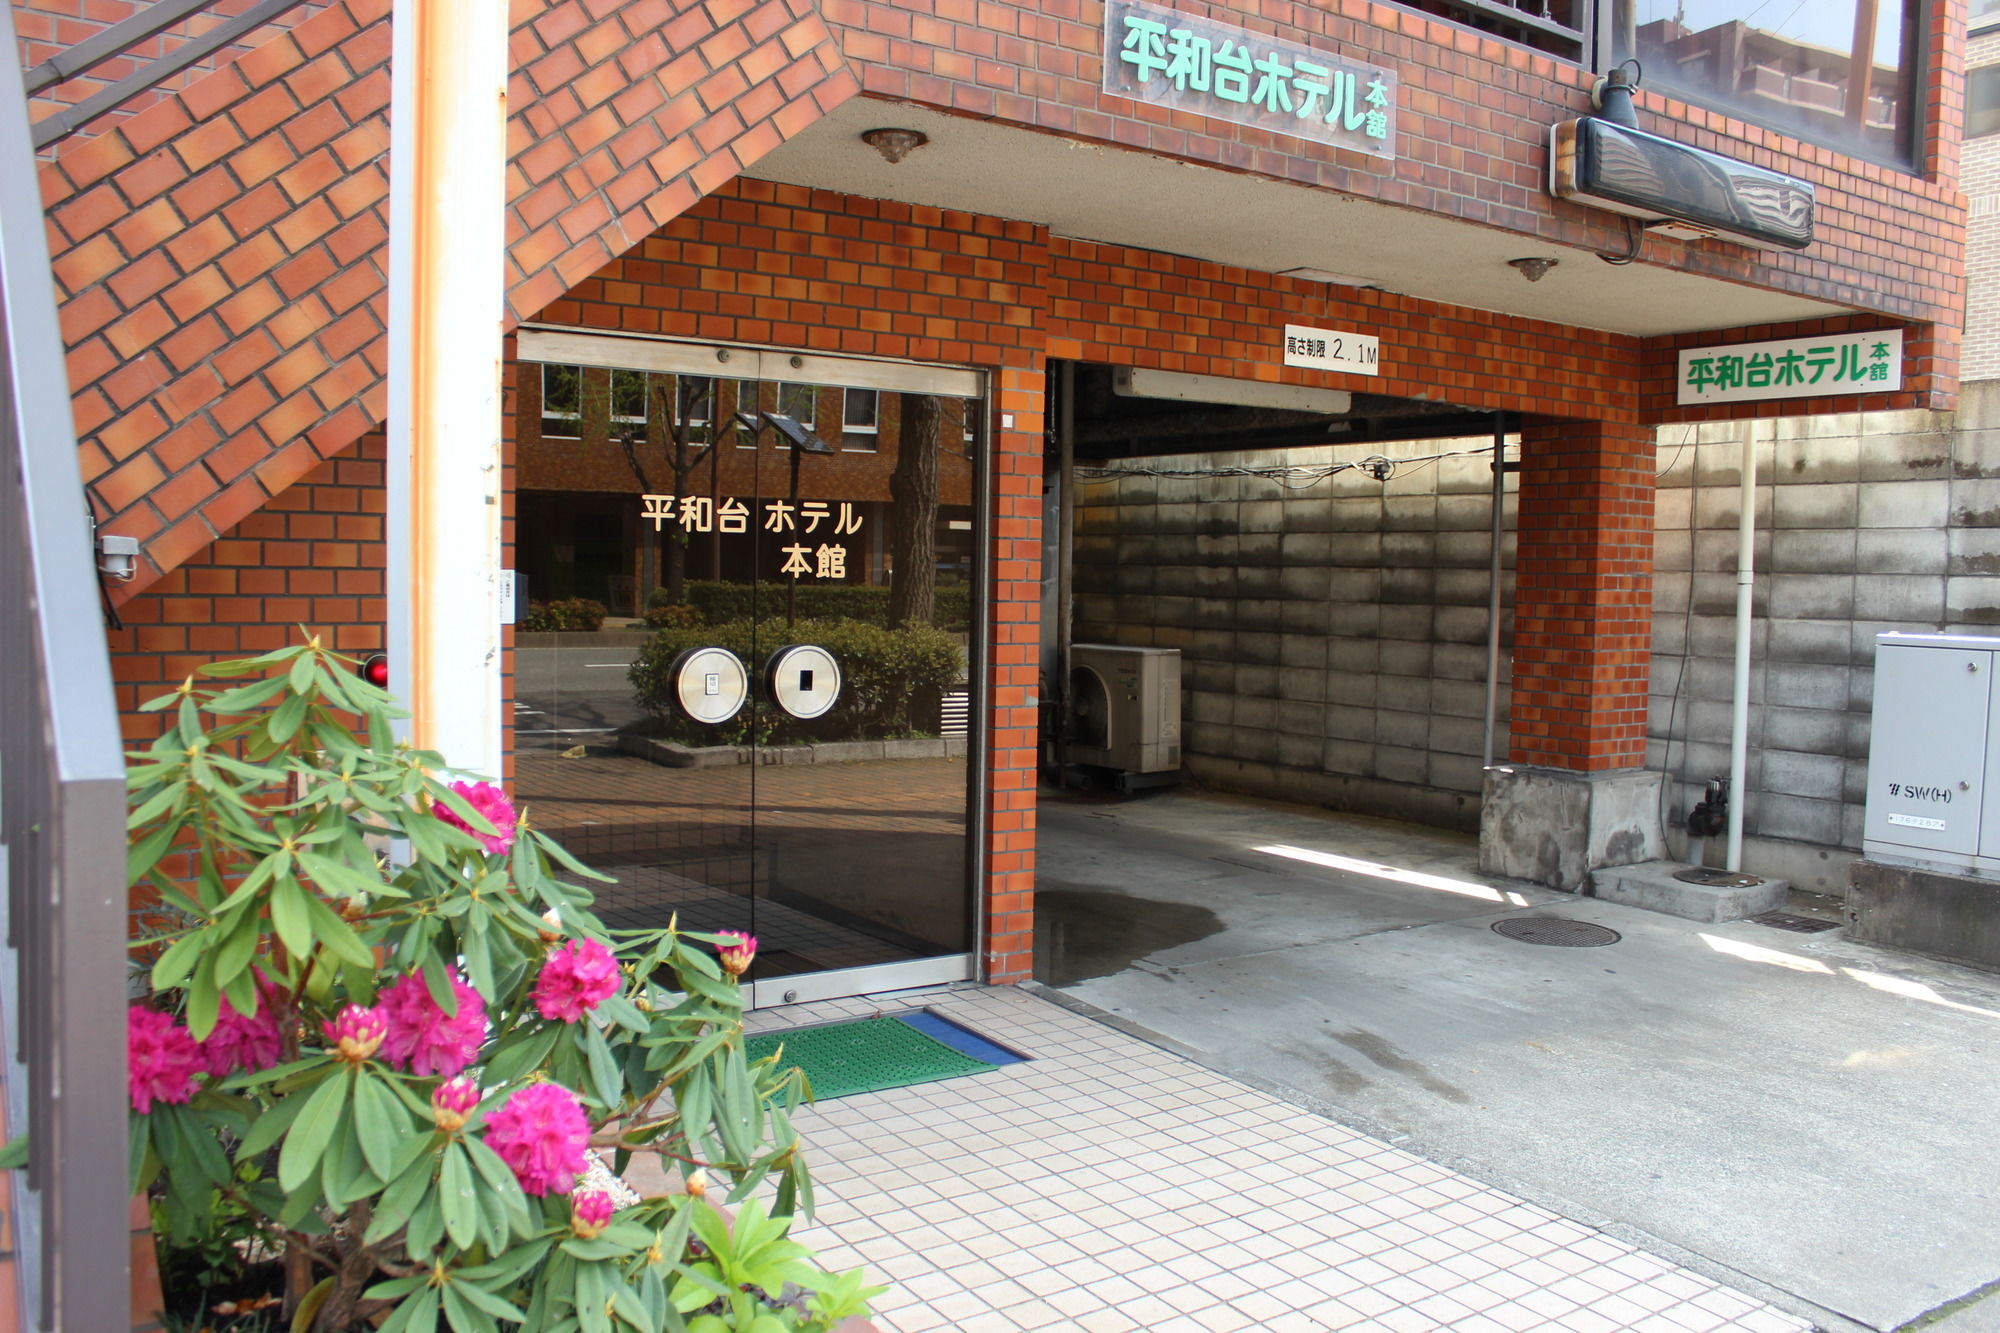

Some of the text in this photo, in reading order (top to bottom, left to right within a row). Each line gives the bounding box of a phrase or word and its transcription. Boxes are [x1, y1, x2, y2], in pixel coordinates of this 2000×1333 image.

[1120, 15, 1366, 132] 平和台ホテル
[1287, 336, 1326, 358] 高さ制限
[1686, 343, 1868, 394] 平和台ホテル
[641, 494, 863, 535] 平和台 ホテル
[781, 542, 847, 579] 本館
